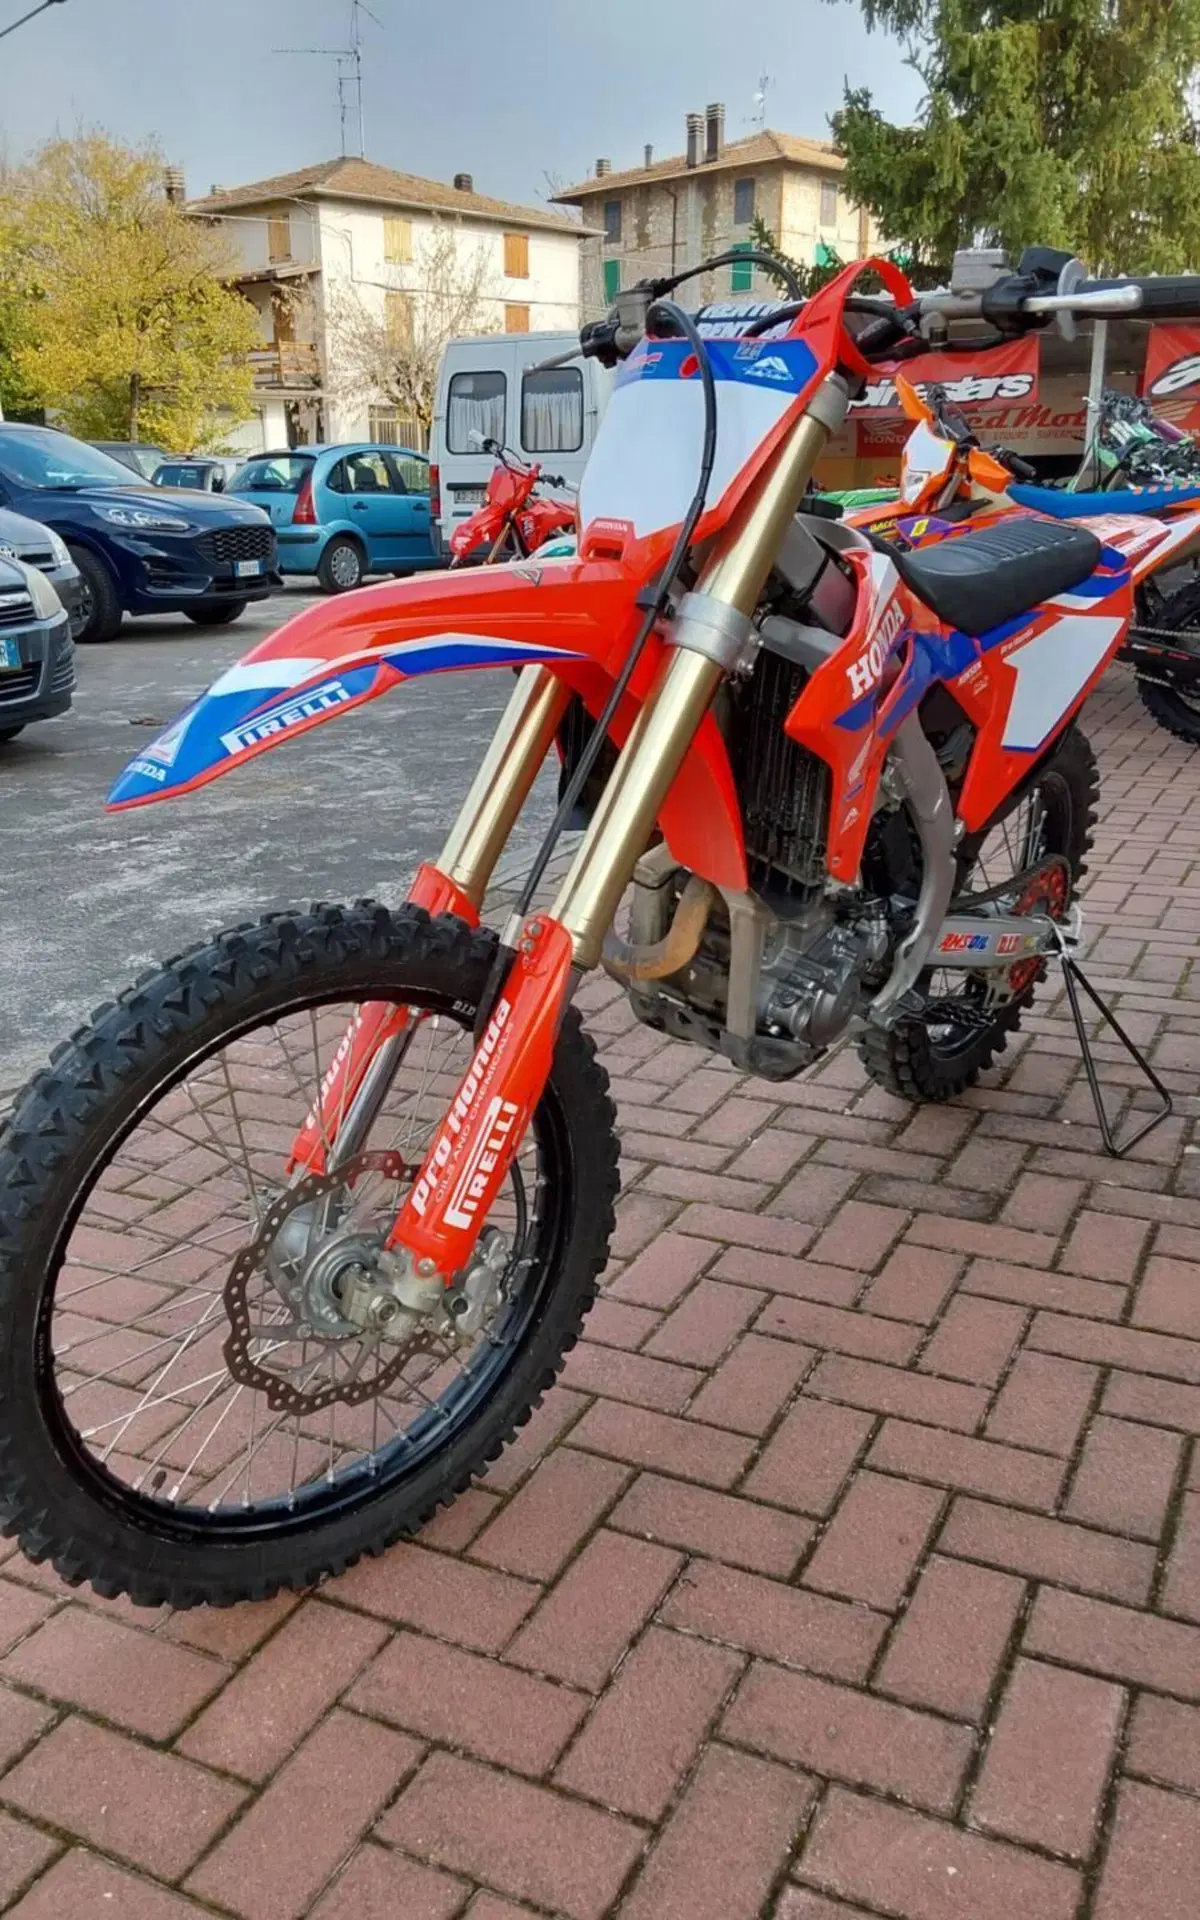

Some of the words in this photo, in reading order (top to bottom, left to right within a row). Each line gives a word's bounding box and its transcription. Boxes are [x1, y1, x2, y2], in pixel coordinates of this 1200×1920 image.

[864, 435, 906, 445] HOND
[846, 598, 905, 700] HONDA
[219, 680, 352, 756] PIRELLI
[447, 997, 511, 1134] Honda
[442, 1096, 519, 1231] PIRELLI
[453, 1124, 471, 1161] AND
